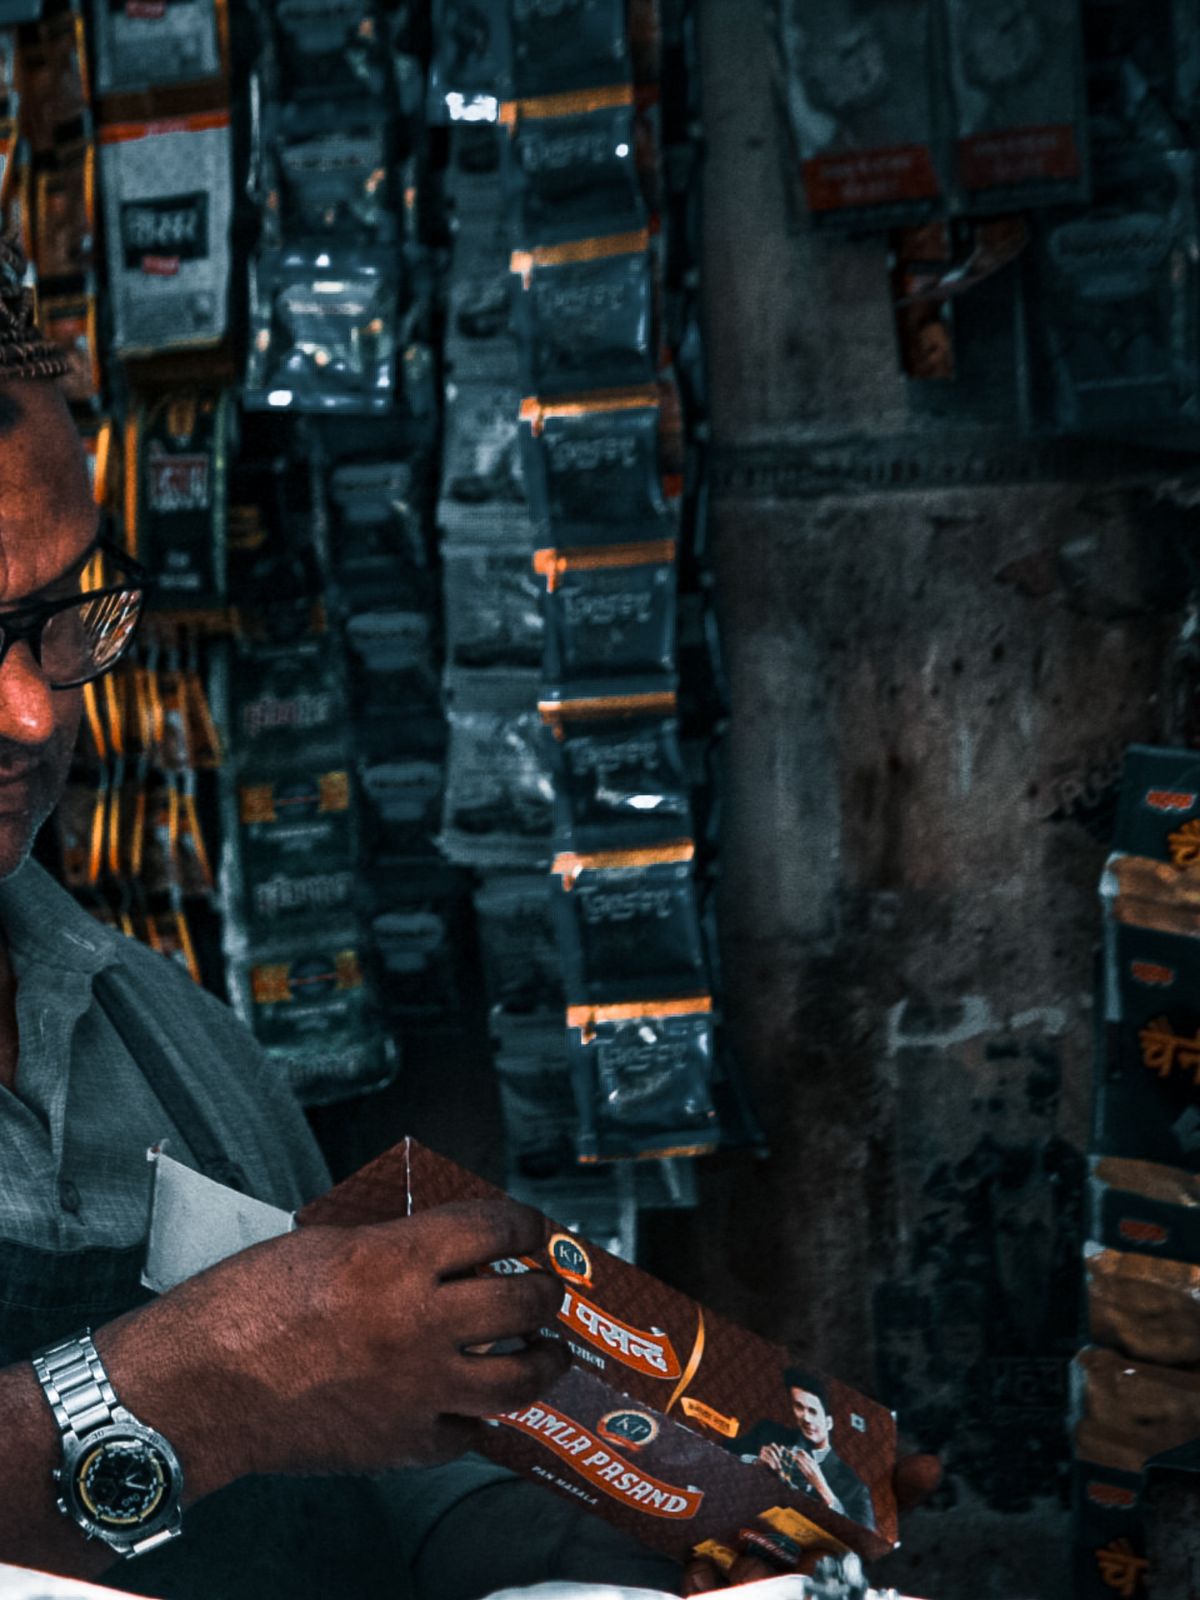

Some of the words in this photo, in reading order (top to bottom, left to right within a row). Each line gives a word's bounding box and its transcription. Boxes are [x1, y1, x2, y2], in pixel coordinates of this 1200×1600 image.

[558, 1244, 585, 1266] KP
[575, 1302, 669, 1373] पसन्द
[616, 1416, 649, 1435] KP
[531, 1464, 555, 1481] PAN
[554, 1478, 600, 1506] MASALA
[581, 1449, 689, 1514] PASAND
